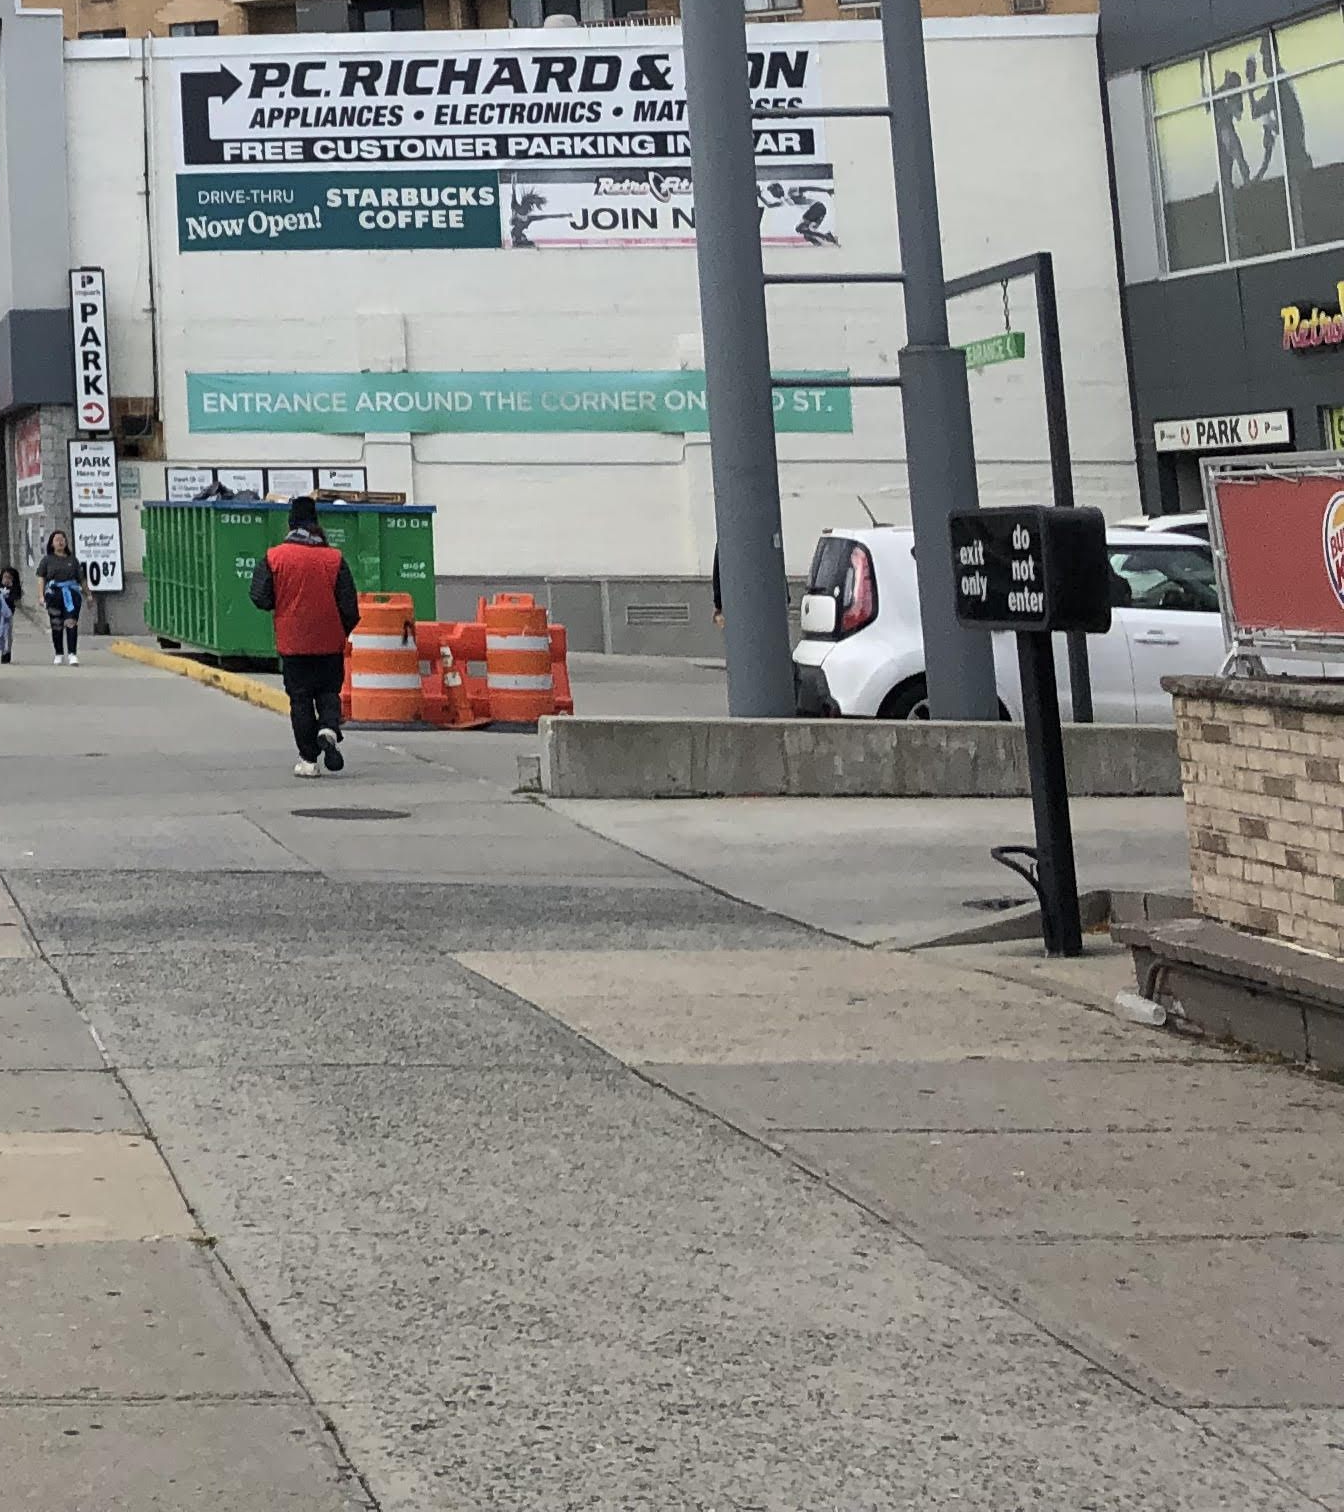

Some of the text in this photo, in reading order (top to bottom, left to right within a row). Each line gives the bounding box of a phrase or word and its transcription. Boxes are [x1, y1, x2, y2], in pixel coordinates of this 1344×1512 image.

[629, 54, 674, 92] &
[249, 105, 403, 129] APPLIANCES
[434, 101, 602, 125] ELECTRONICS
[223, 140, 304, 161] FREE
[313, 138, 497, 159] CUSTOMER
[508, 134, 656, 156] PARKING
[198, 190, 294, 205] DRIVE-THRU
[326, 187, 494, 208] STARBUCKS
[186, 205, 322, 240] Now Open!
[358, 210, 465, 229] COFFEE
[569, 207, 658, 231] JOIN
[80, 303, 104, 395] PARK
[203, 392, 347, 413] ENTRANCE
[355, 391, 473, 413] AROUND
[480, 391, 533, 412] THE
[541, 391, 656, 412] CORNER
[665, 390, 707, 411] ON
[793, 390, 832, 412] ST.
[1196, 418, 1242, 446] PARK
[75, 456, 111, 467] PARK
[1012, 523, 1030, 550] do
[960, 539, 984, 565] exit
[1012, 554, 1035, 581] not
[961, 570, 987, 602] only
[1008, 586, 1043, 612] enter
